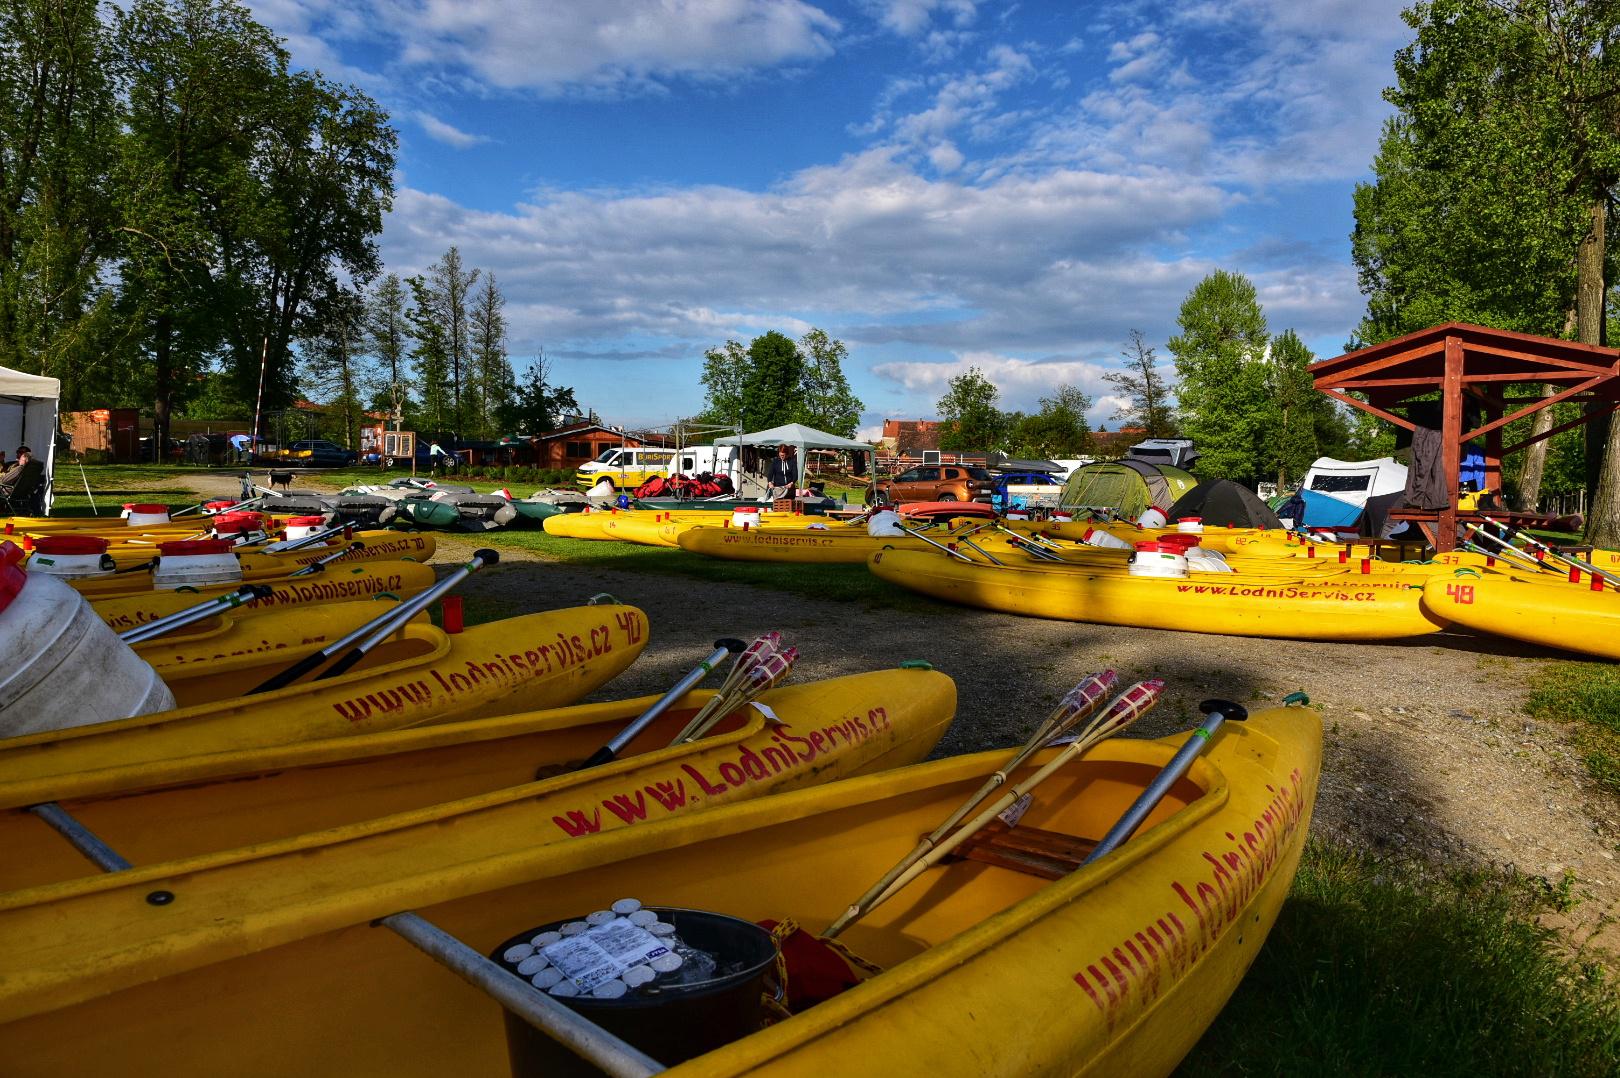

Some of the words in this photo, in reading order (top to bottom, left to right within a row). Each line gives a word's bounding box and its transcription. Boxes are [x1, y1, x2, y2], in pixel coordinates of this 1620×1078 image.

[1176, 584, 1376, 602] www.LodniServis.cz
[1446, 583, 1474, 604] 48
[333, 624, 612, 722] www.lodniservis.cz
[616, 611, 642, 647] 40
[552, 706, 890, 838] www.LodniServis.cz
